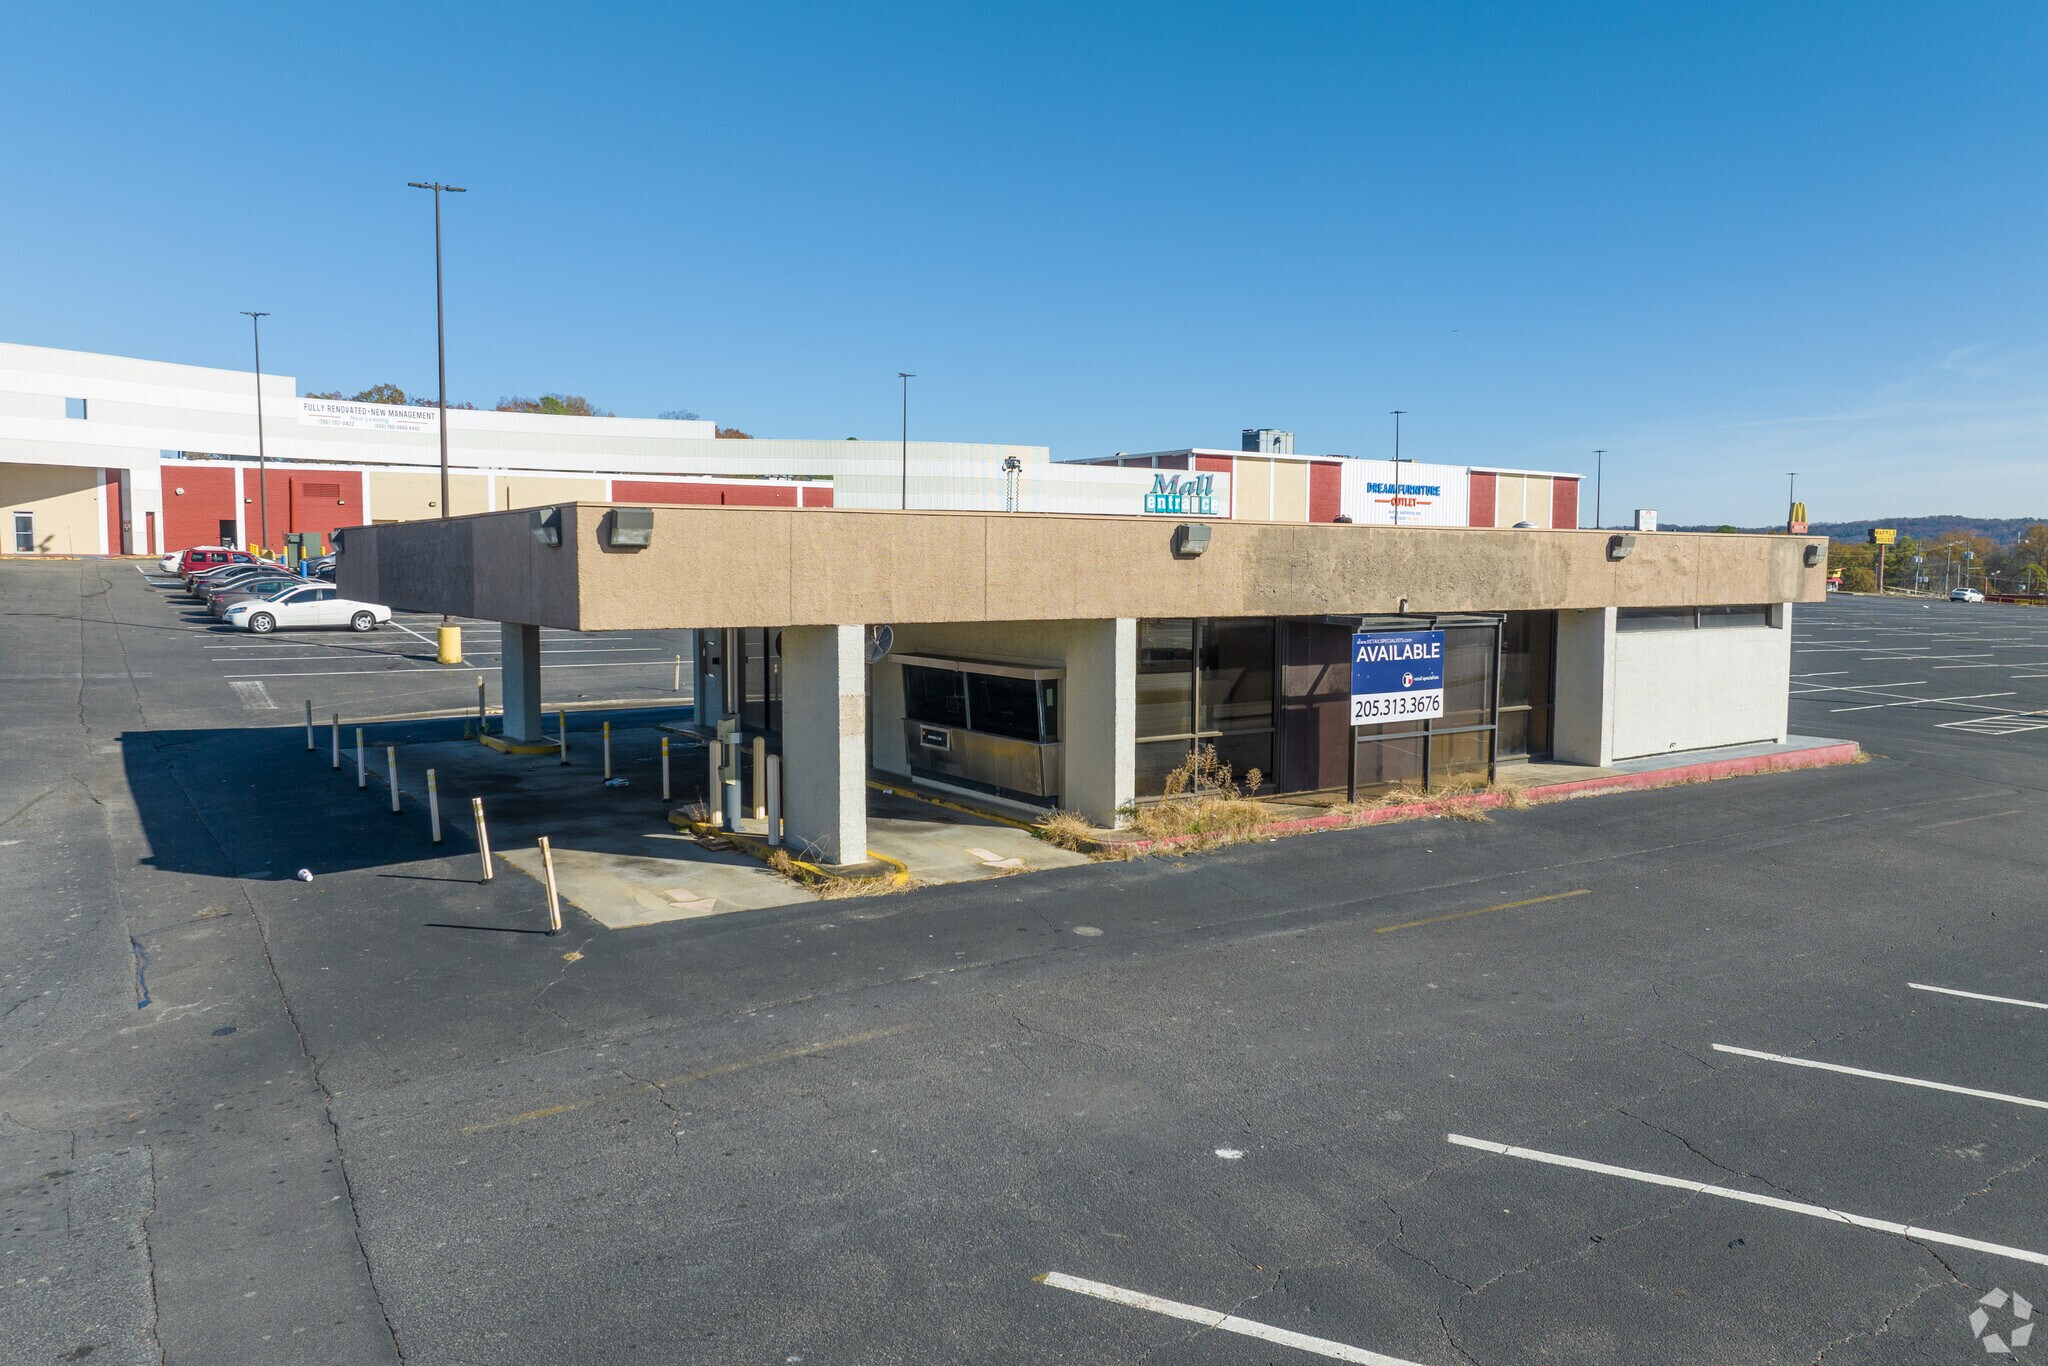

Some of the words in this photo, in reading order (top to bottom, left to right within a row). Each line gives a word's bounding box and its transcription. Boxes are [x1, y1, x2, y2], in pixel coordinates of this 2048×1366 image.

[304, 403, 325, 411] FULLY
[388, 410, 435, 420] MANAGEMENT
[1149, 473, 1214, 496] Mall
[1367, 482, 1396, 494] DREAM
[1397, 483, 1441, 496] FURNITURE
[1390, 497, 1417, 507] OUTLET
[1356, 642, 1440, 662] AVAILABLE
[1355, 695, 1440, 718] 205.313.3676
